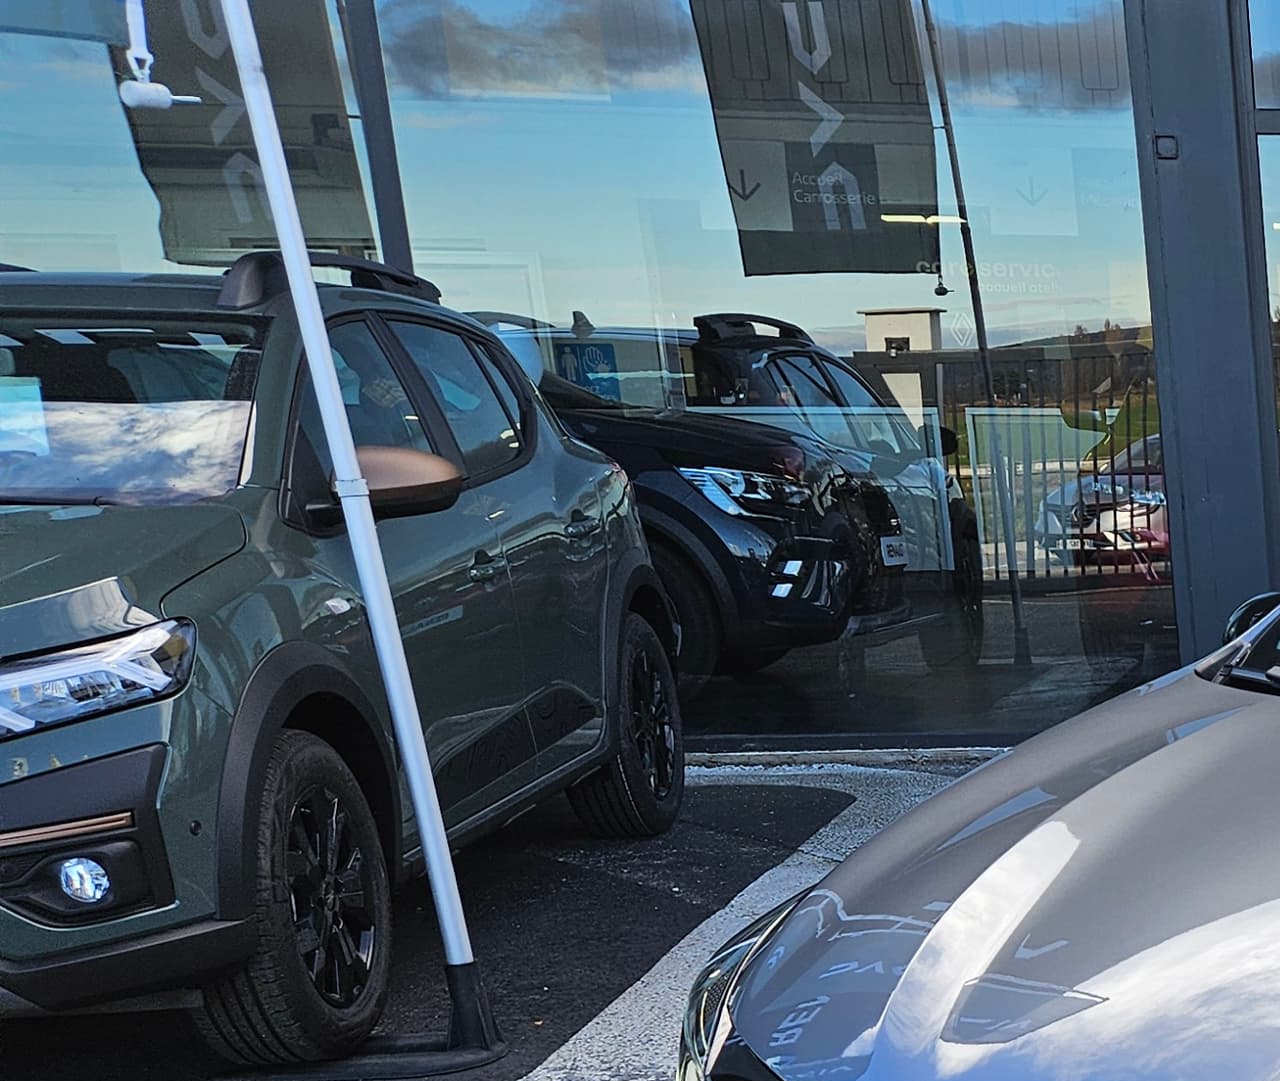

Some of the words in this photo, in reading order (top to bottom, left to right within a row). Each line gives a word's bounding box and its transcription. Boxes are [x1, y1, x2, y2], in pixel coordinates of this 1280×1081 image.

[792, 171, 844, 186] Accueil
[793, 189, 876, 205] Carrosserie
[980, 258, 1056, 278] servic
